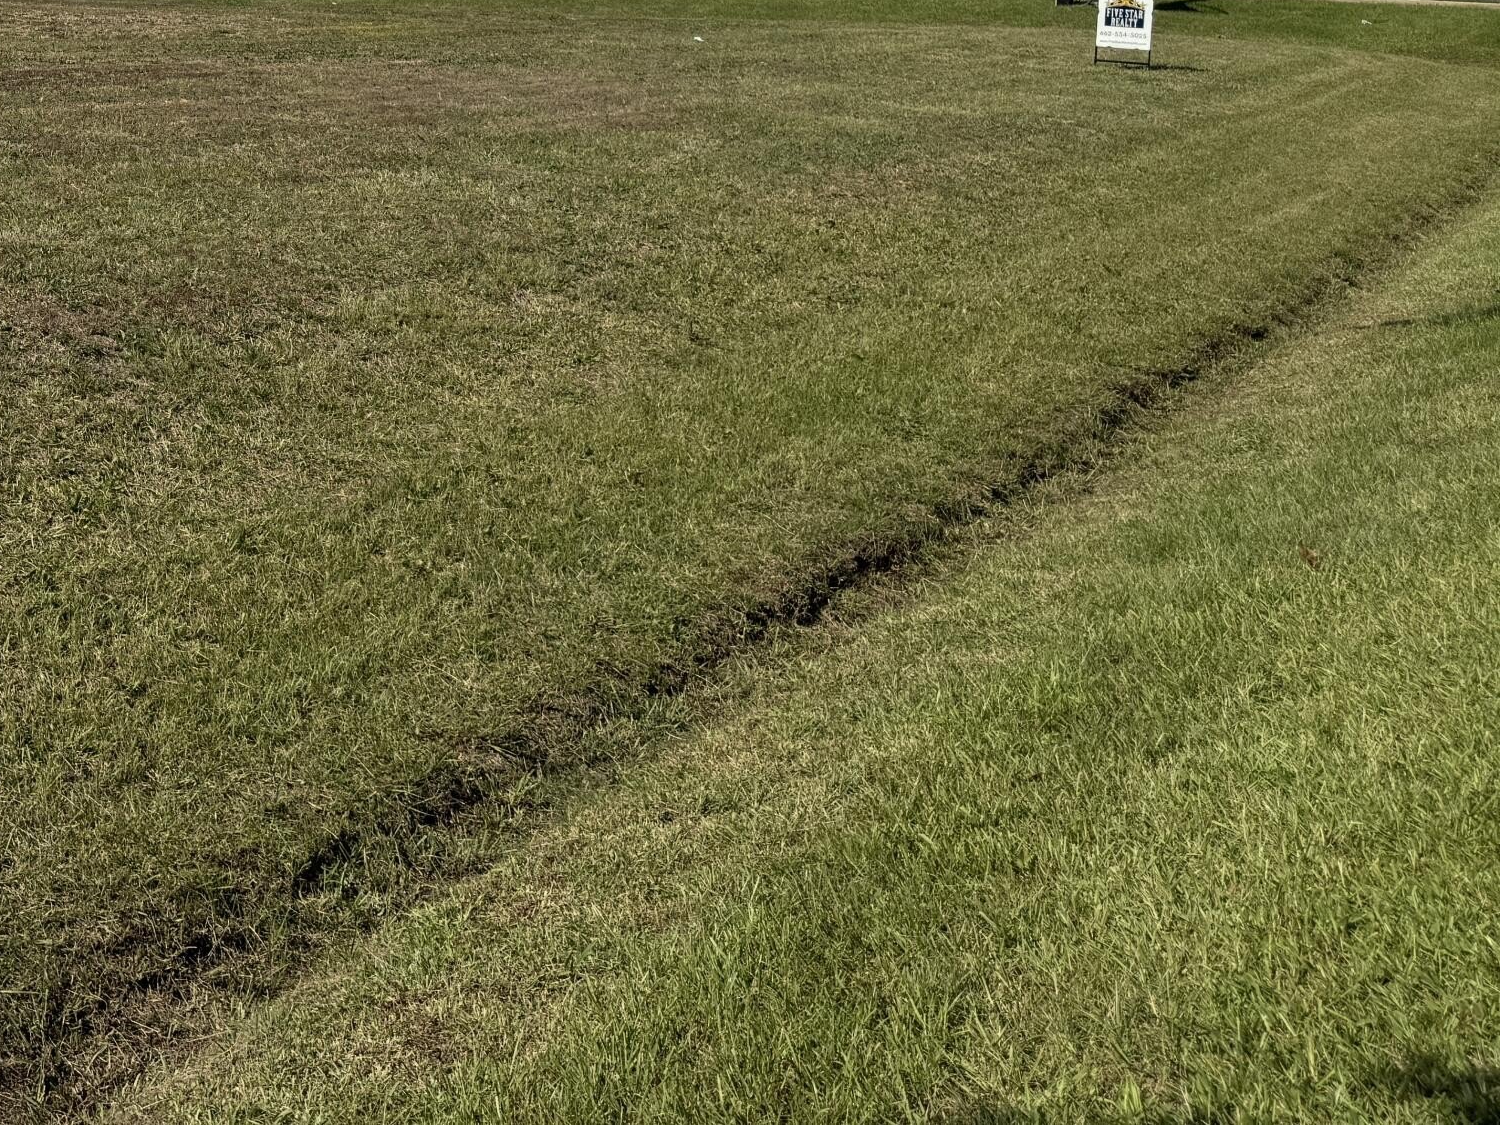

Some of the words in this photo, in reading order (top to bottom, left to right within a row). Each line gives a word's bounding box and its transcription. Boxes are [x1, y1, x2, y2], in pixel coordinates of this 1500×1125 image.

[1106, 7, 1124, 18] FIVE
[1125, 9, 1144, 20] STAR
[1110, 17, 1138, 28] REALTY
